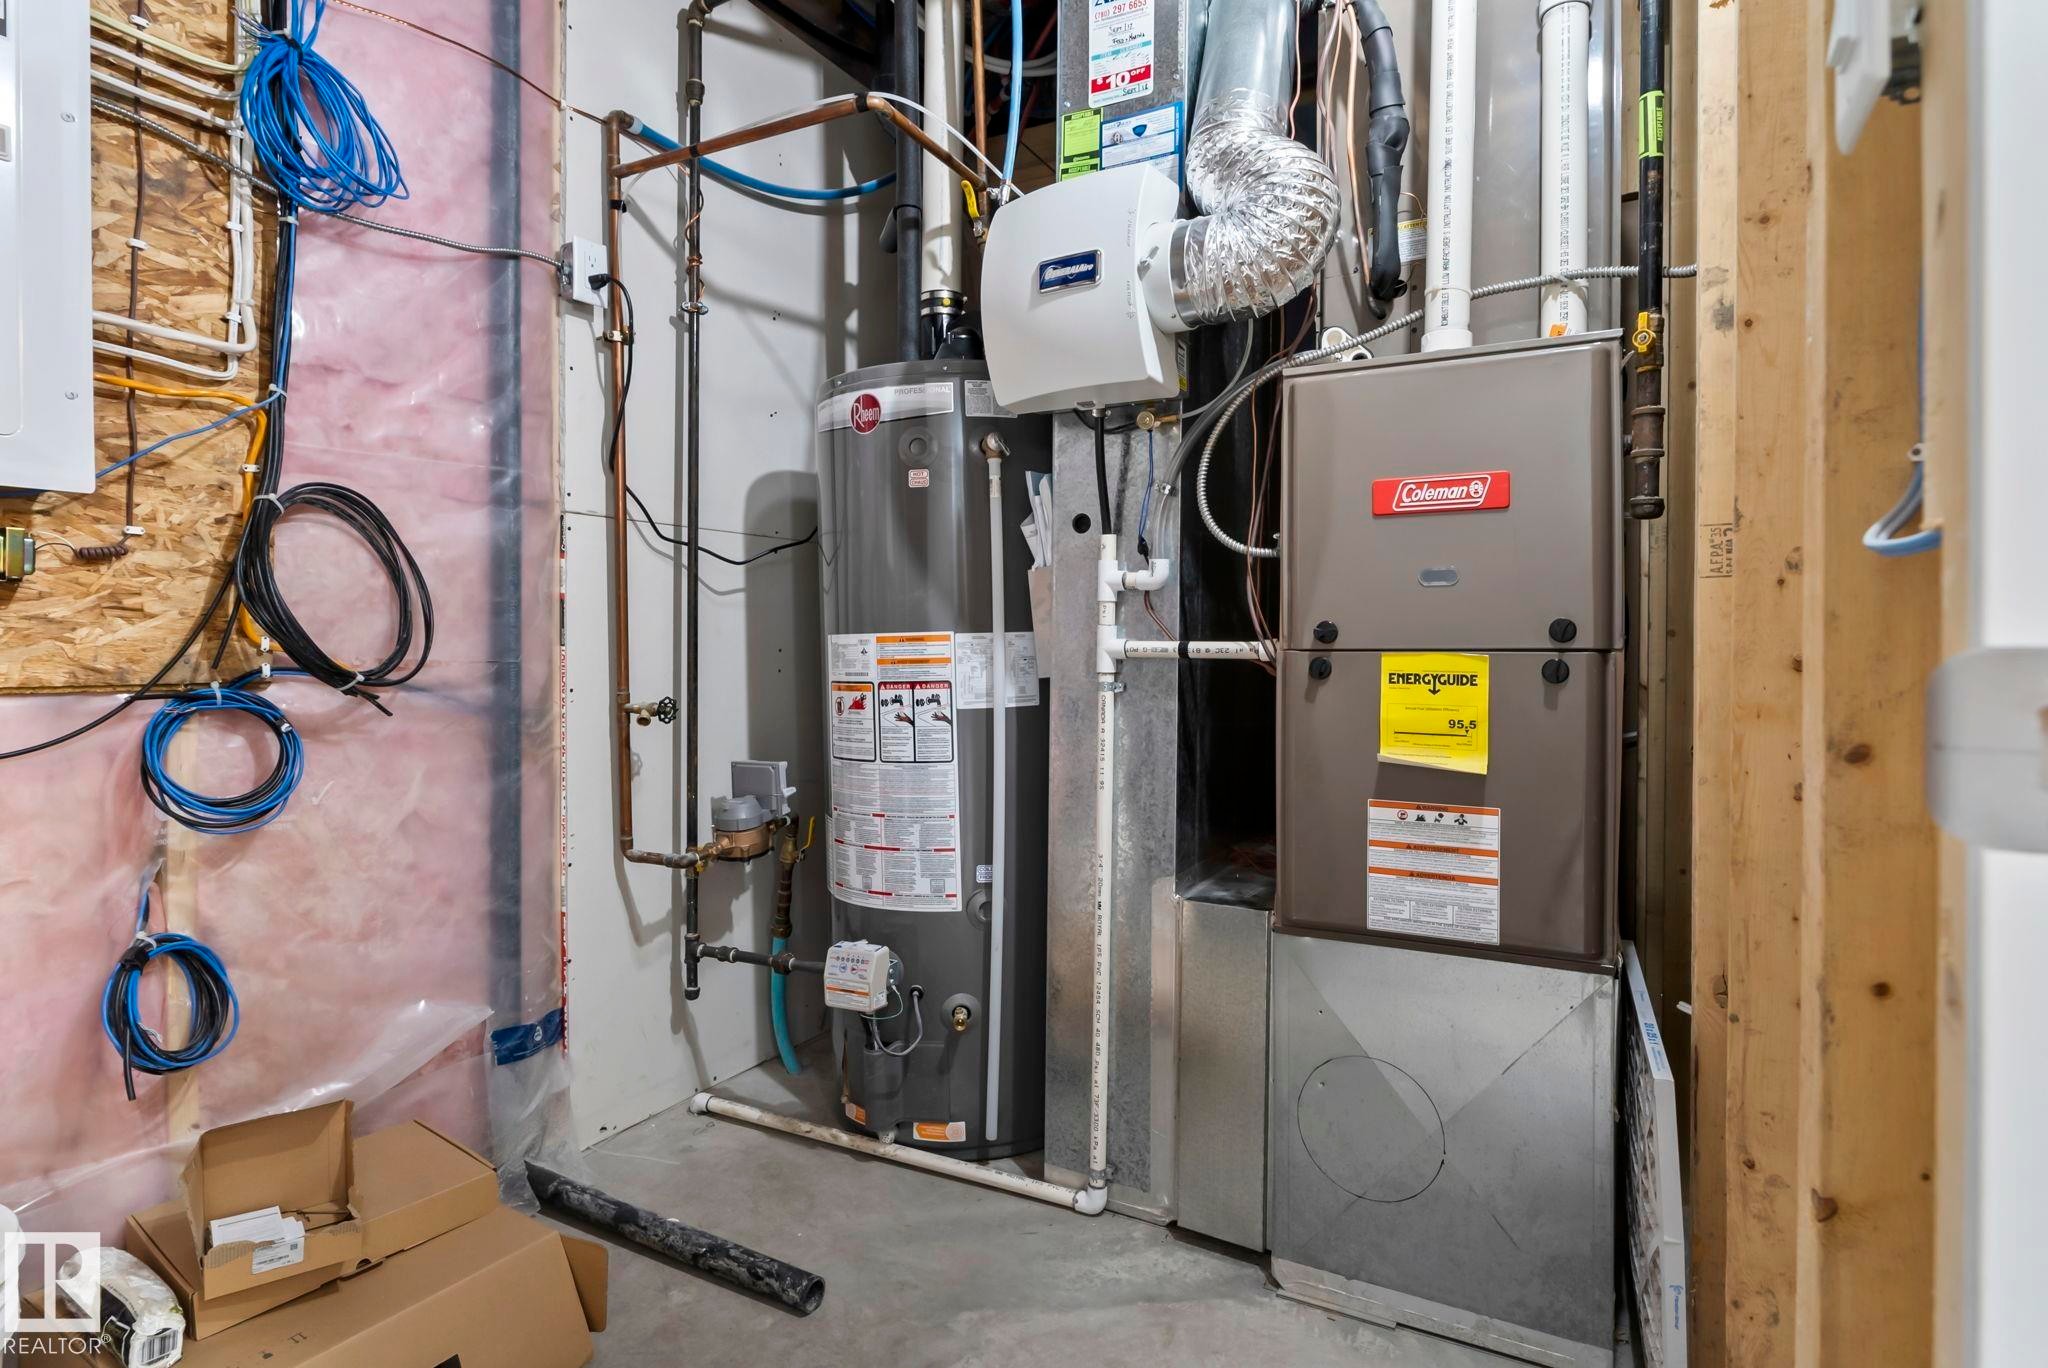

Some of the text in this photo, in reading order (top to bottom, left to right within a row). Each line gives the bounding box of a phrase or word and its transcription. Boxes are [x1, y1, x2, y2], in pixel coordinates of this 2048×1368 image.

[1113, 3, 1126, 15] 297
[1130, 67, 1146, 76] OFF
[894, 384, 952, 396] PROFESSIONAL
[853, 395, 880, 428] Rheem
[1401, 483, 1468, 503] Coleman
[1448, 719, 1477, 729] 95.5
